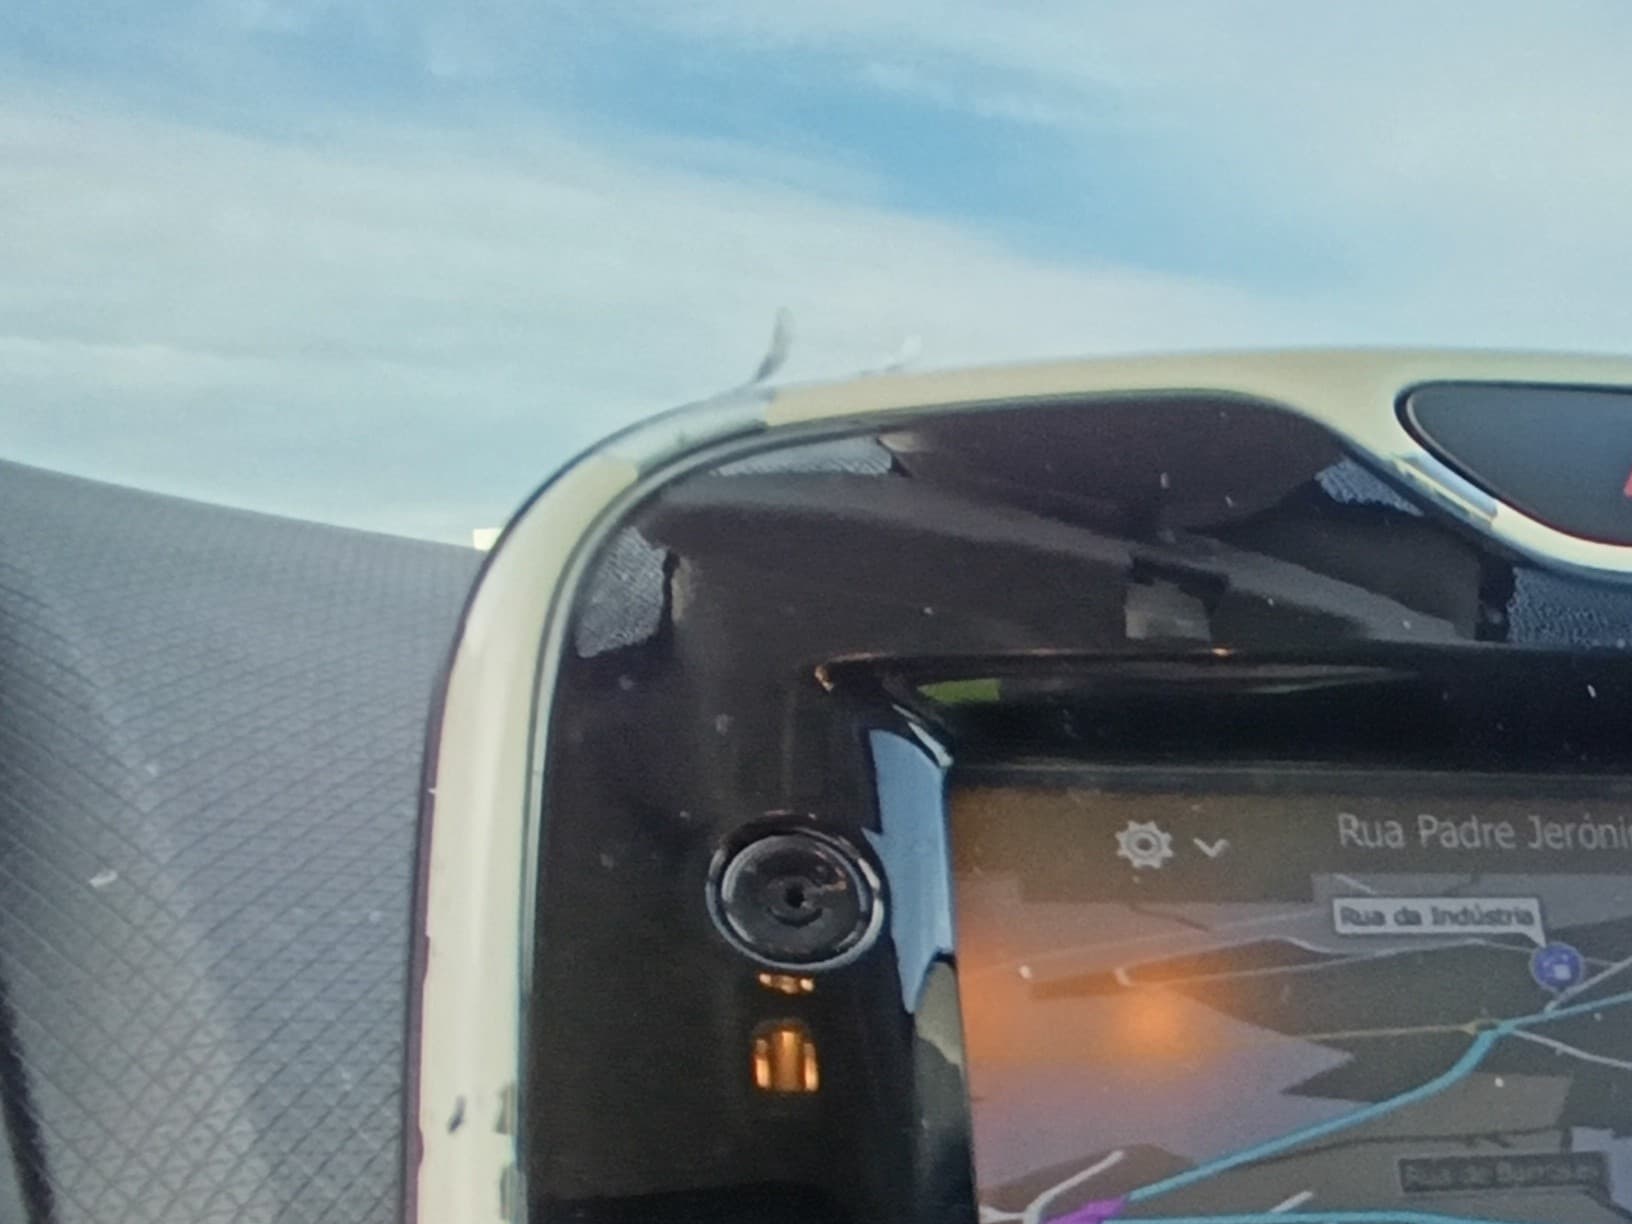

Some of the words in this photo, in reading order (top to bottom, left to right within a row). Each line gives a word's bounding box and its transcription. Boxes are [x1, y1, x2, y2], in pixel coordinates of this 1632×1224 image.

[1338, 813, 1404, 849] Rua
[1418, 813, 1515, 850] Padre
[1340, 905, 1386, 927] Rua
[1393, 905, 1423, 927] da
[1430, 902, 1536, 927] Indústria
